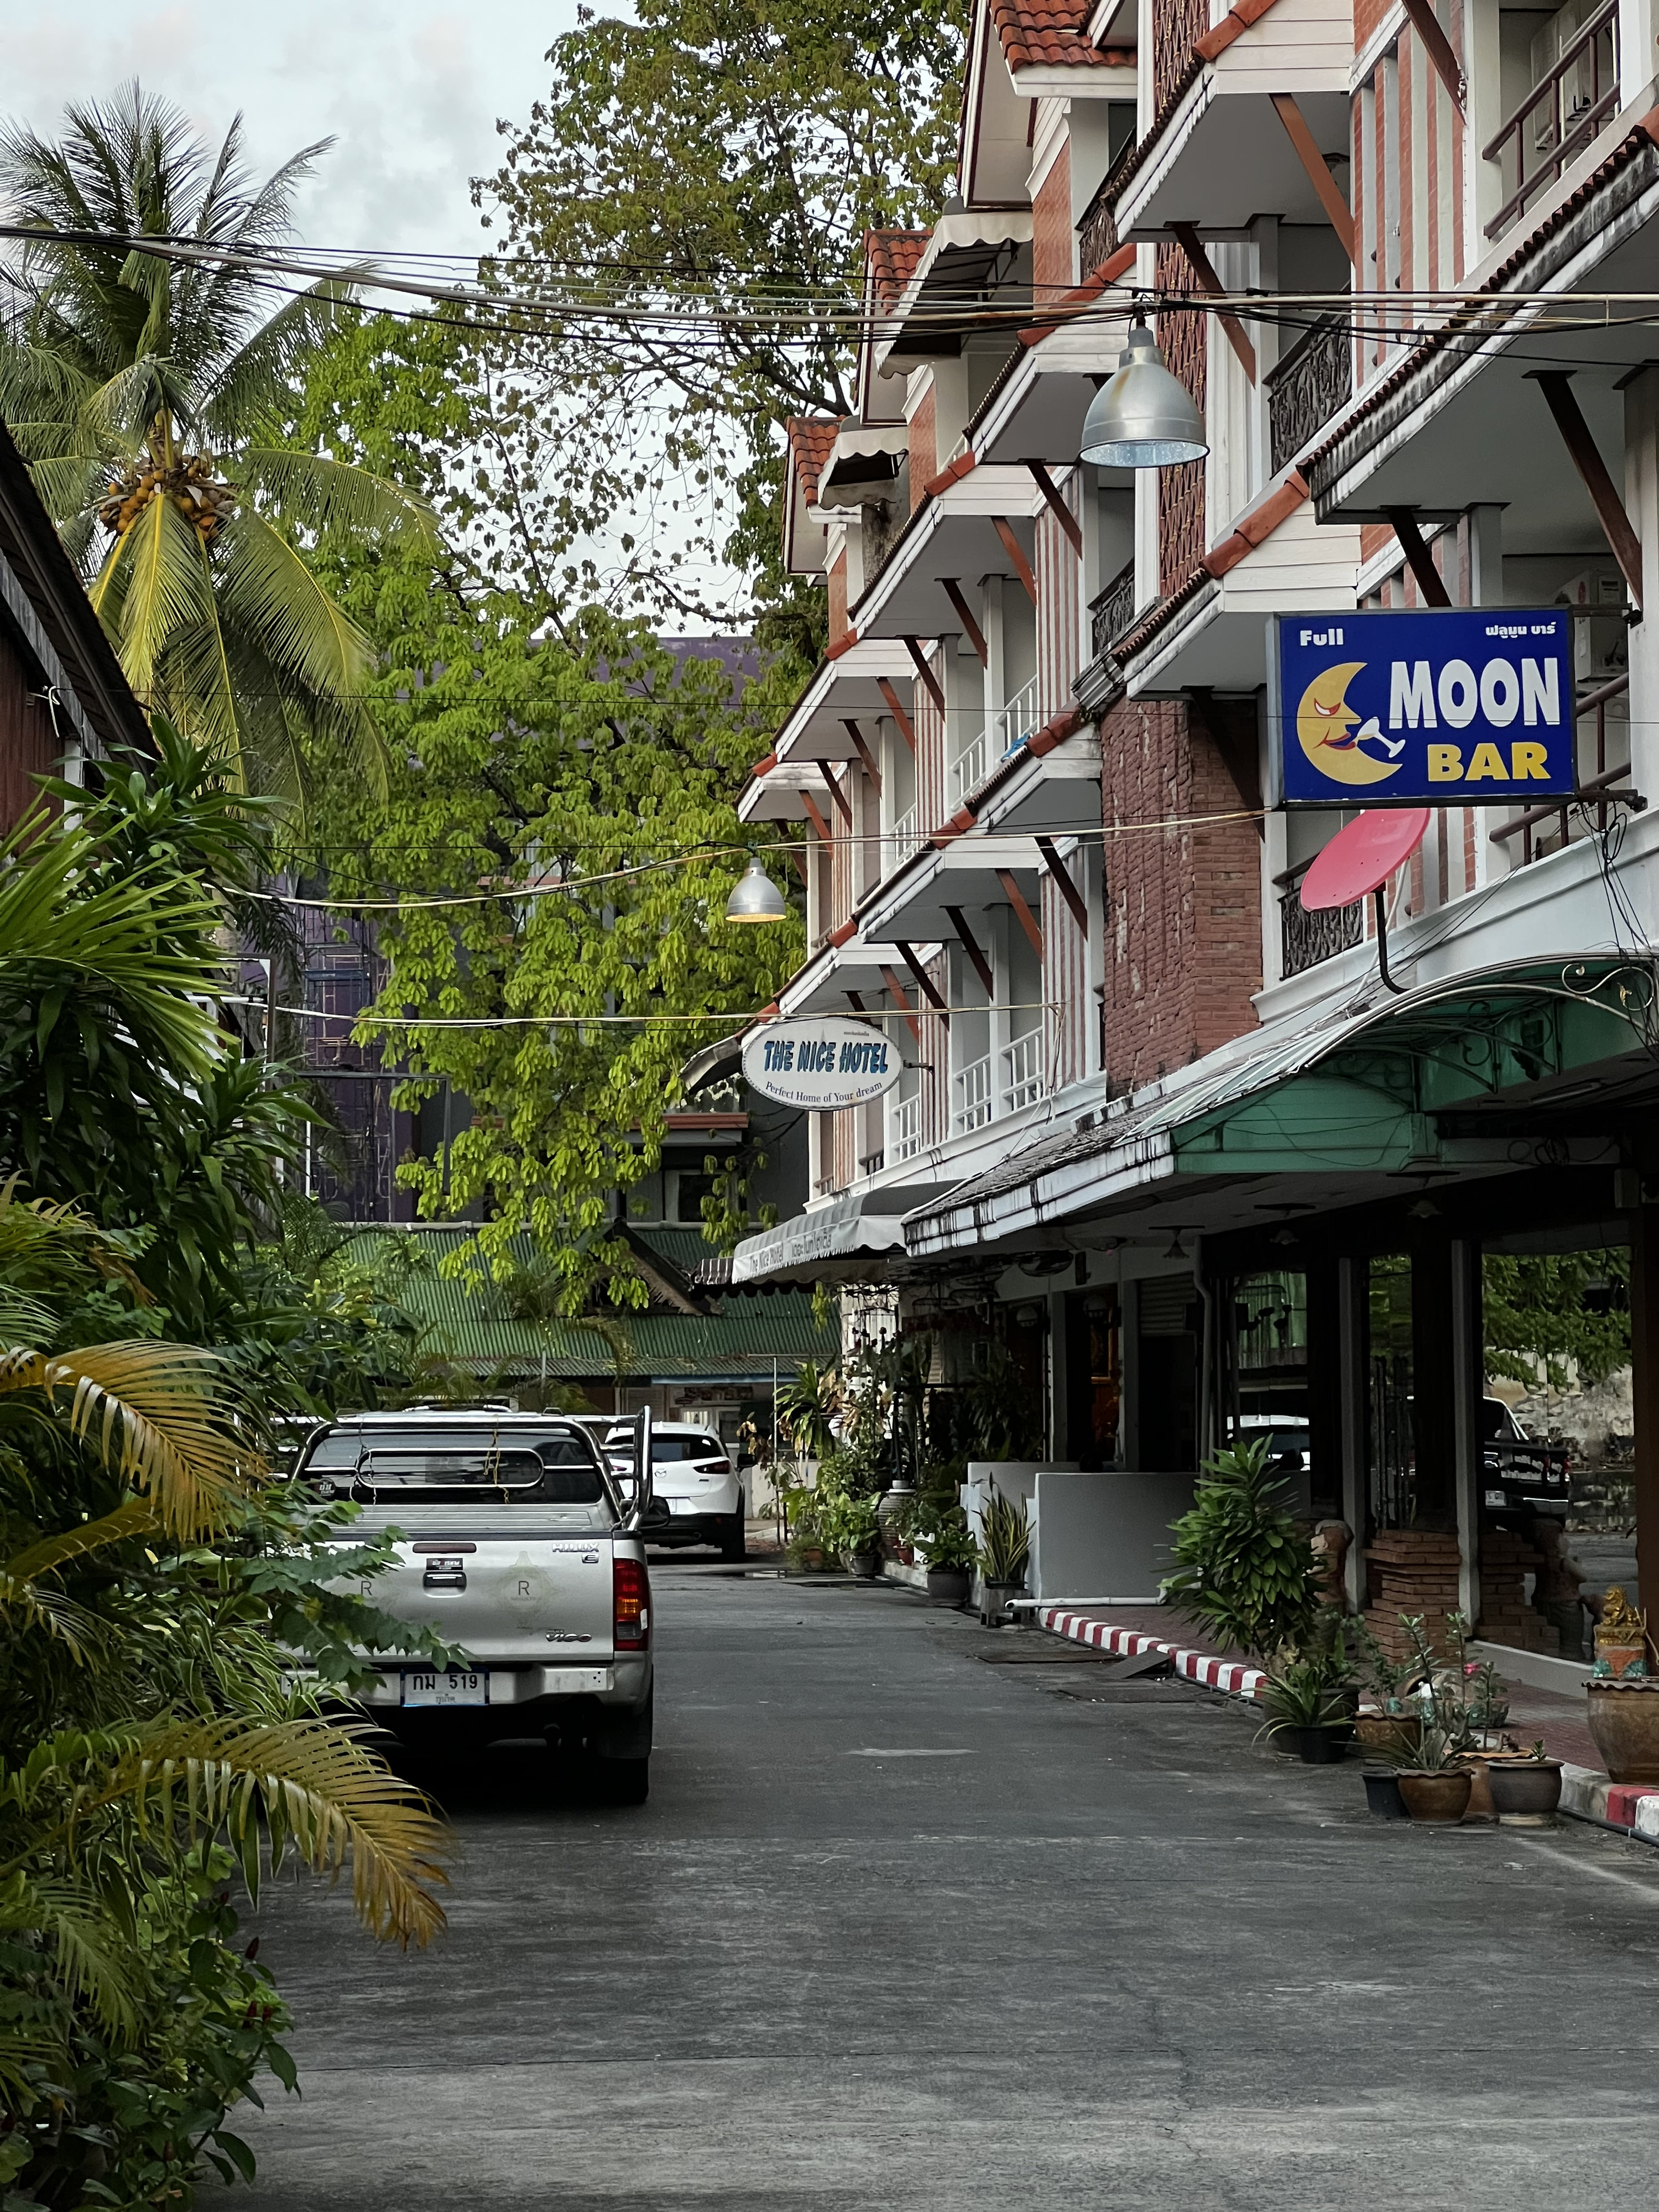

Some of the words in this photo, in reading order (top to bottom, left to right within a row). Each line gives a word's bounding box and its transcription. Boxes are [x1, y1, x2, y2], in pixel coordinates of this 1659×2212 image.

[1300, 628, 1344, 646] Full
[1485, 625, 1527, 639] ฟลูมูน
[1531, 622, 1556, 634] บาร์
[1389, 658, 1560, 729] MOON
[1427, 742, 1551, 781] BAR
[764, 1041, 795, 1072] THE
[797, 1041, 836, 1072] NICE
[839, 1042, 888, 1073] HOTEL
[766, 1081, 794, 1099] Perfect
[796, 1091, 821, 1102] Home
[823, 1093, 832, 1103] of
[833, 1093, 854, 1102] Your
[856, 1082, 883, 1098] dream
[552, 1543, 599, 1552] HILUX
[361, 1580, 373, 1595] R
[518, 1580, 530, 1595] R
[413, 1675, 435, 1690] กม
[449, 1674, 477, 1689] 519
